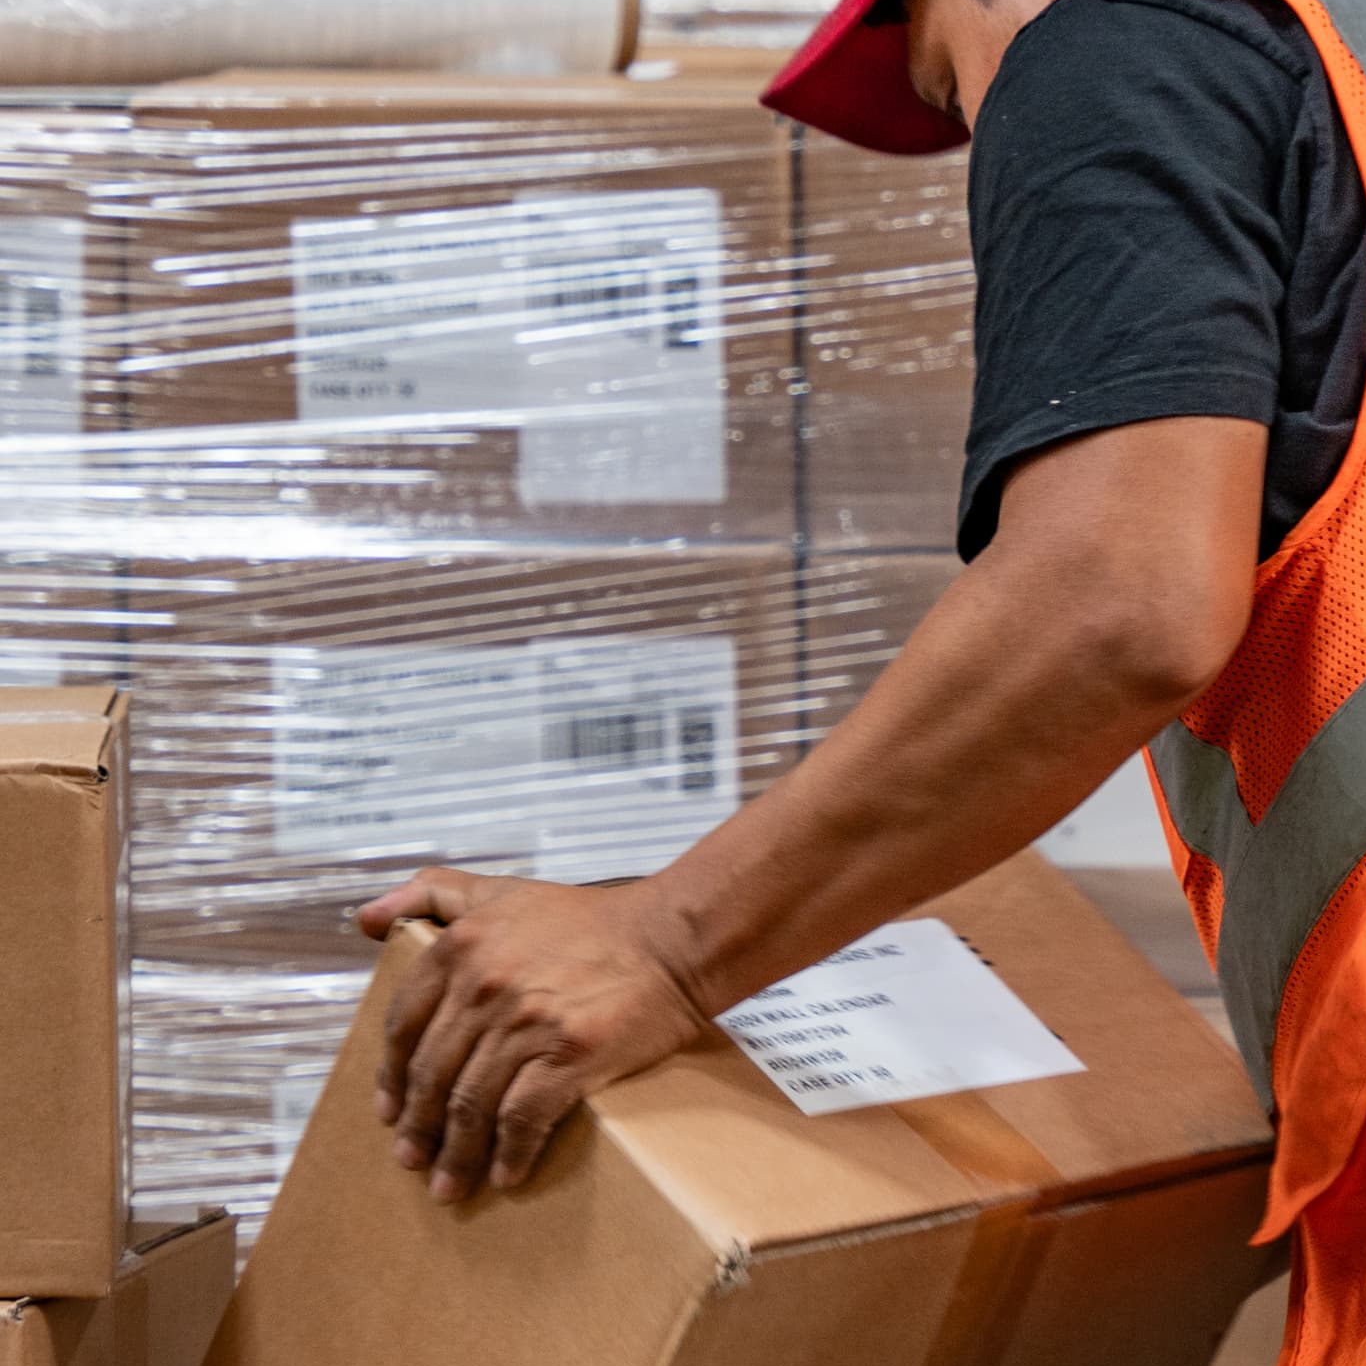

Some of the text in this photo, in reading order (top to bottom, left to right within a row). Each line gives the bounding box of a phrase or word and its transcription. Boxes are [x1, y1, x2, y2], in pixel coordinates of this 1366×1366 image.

[764, 1006, 808, 1022] WALL
[807, 993, 895, 1016] CALENDAR
[786, 1076, 834, 1094] CASE
